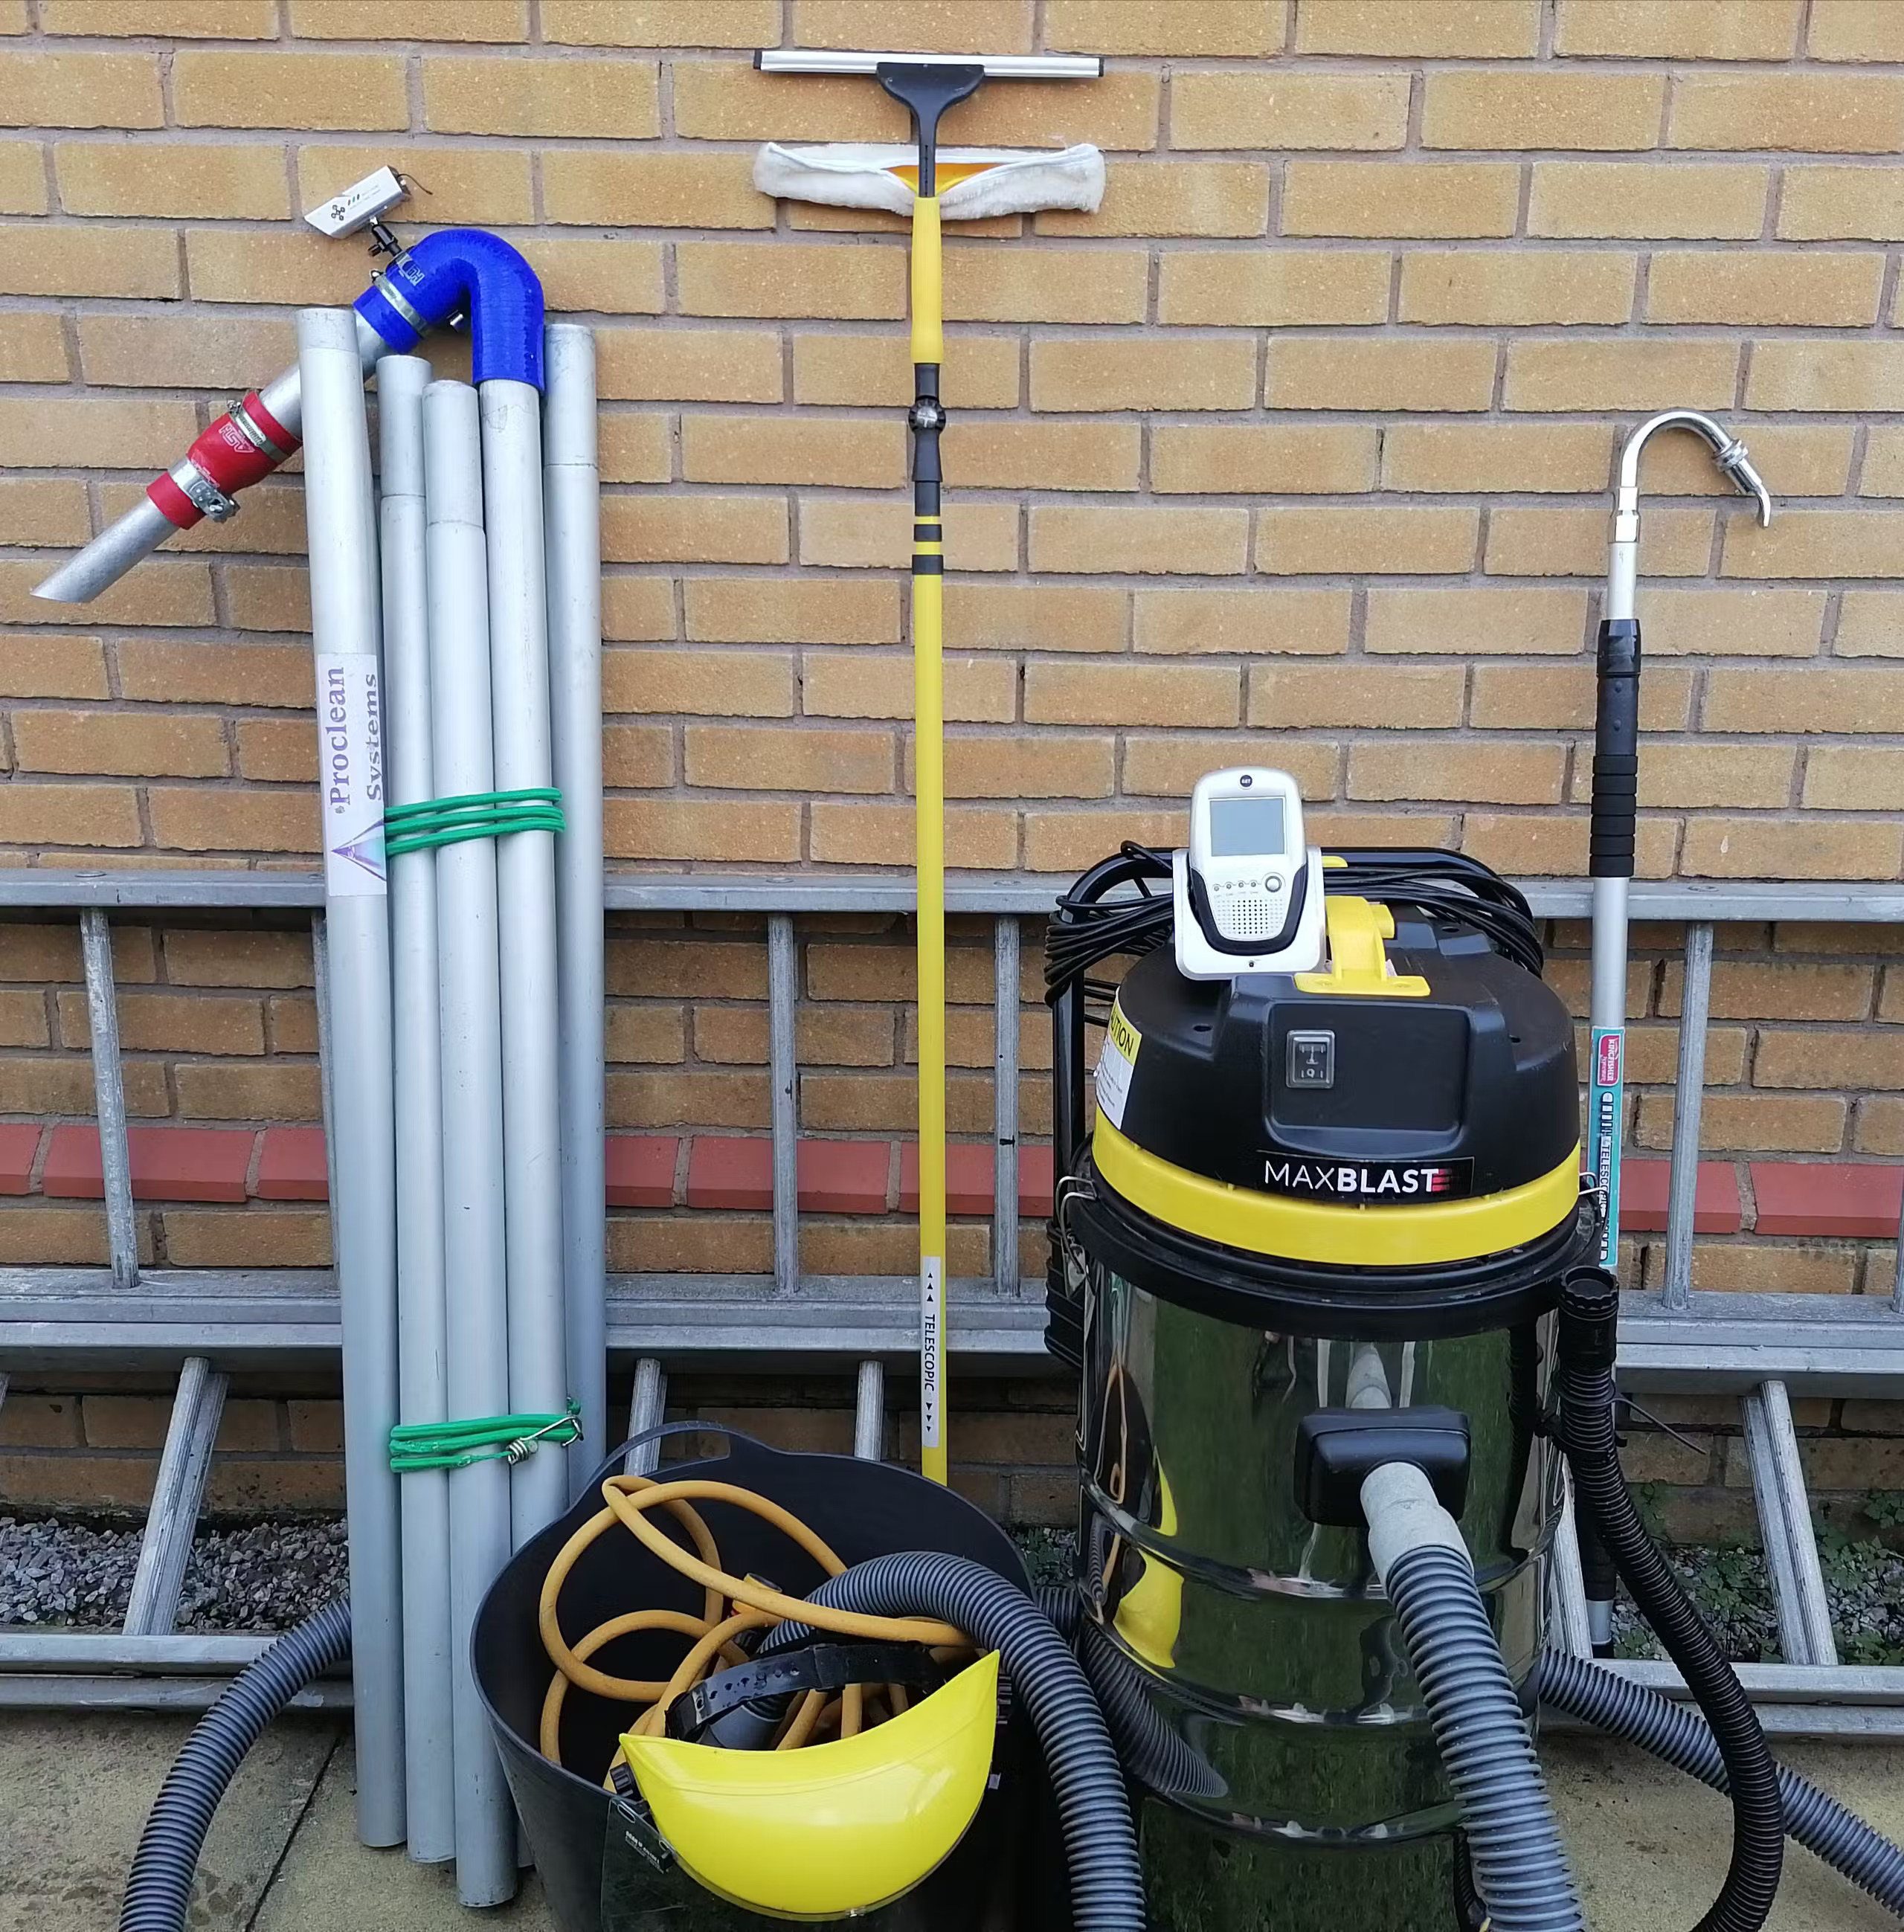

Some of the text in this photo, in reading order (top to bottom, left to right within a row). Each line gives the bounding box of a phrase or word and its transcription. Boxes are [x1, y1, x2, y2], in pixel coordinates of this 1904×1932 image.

[326, 666, 350, 806] Proclean
[365, 673, 382, 802] Systems
[1264, 1160, 1441, 1194] MAXBLAST
[924, 1313, 935, 1392] TELESCOPIC
